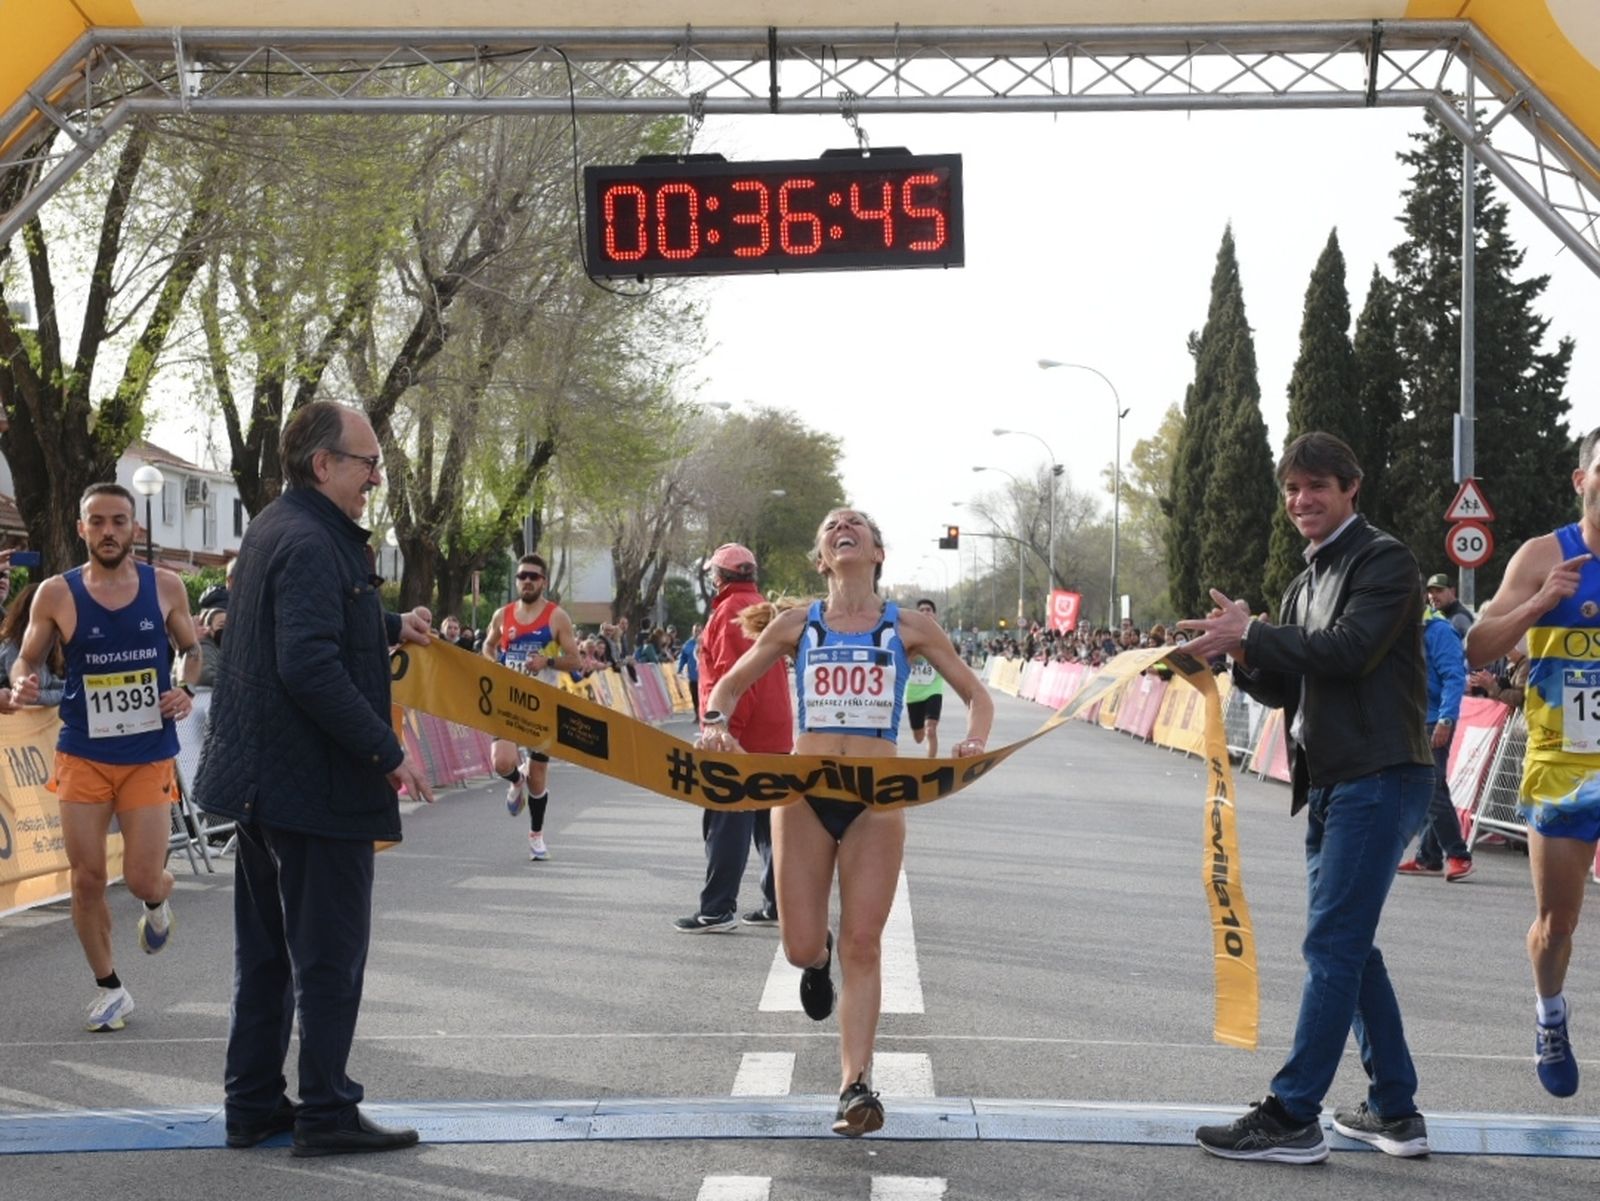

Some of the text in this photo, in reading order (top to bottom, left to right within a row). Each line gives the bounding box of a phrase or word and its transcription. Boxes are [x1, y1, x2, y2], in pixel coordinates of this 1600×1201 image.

[604, 173, 945, 261] 00:36:45
[1456, 536, 1483, 552] 30
[85, 647, 158, 665] TROTASIERRA
[814, 665, 884, 697] 8003
[90, 685, 156, 714] 11393
[509, 686, 540, 712] IMD
[6, 745, 48, 787] IMD
[666, 747, 997, 806] #Sevilla10
[1211, 757, 1243, 957] #Sevilla10
